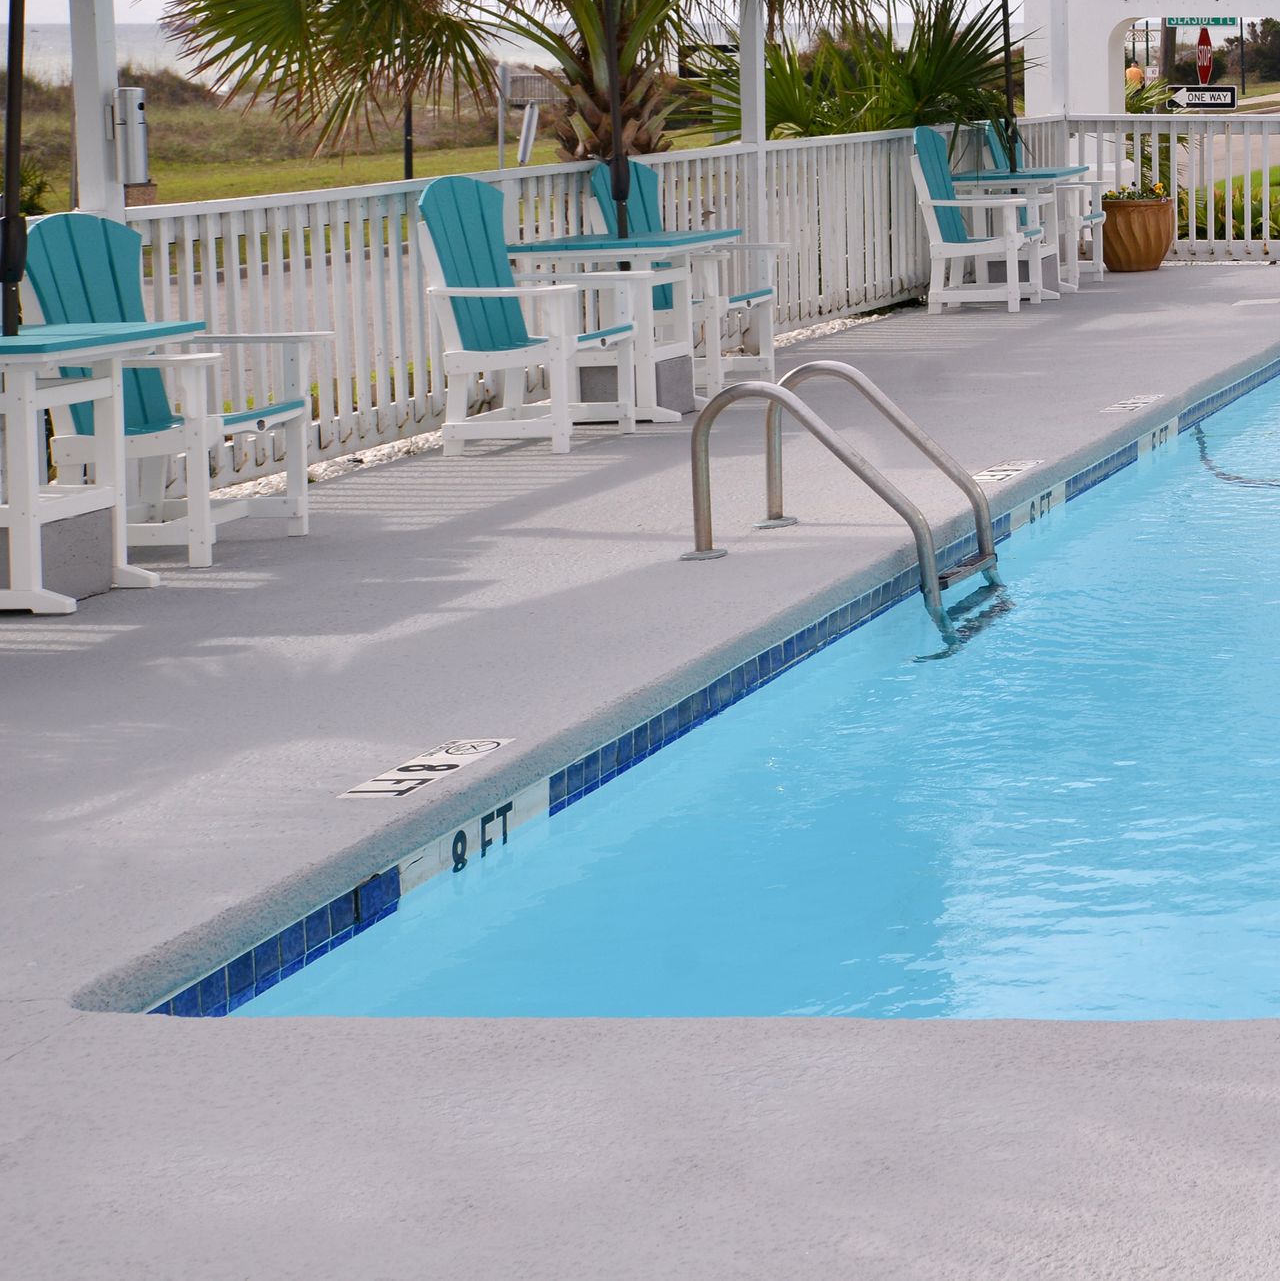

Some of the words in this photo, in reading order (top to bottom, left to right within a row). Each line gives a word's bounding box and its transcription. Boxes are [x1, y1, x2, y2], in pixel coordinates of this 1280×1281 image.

[1198, 45, 1211, 66] STOP
[1187, 93, 1206, 102] ONE
[1209, 93, 1229, 102] WAY
[1040, 490, 1052, 519] FT
[480, 800, 513, 858] FT
